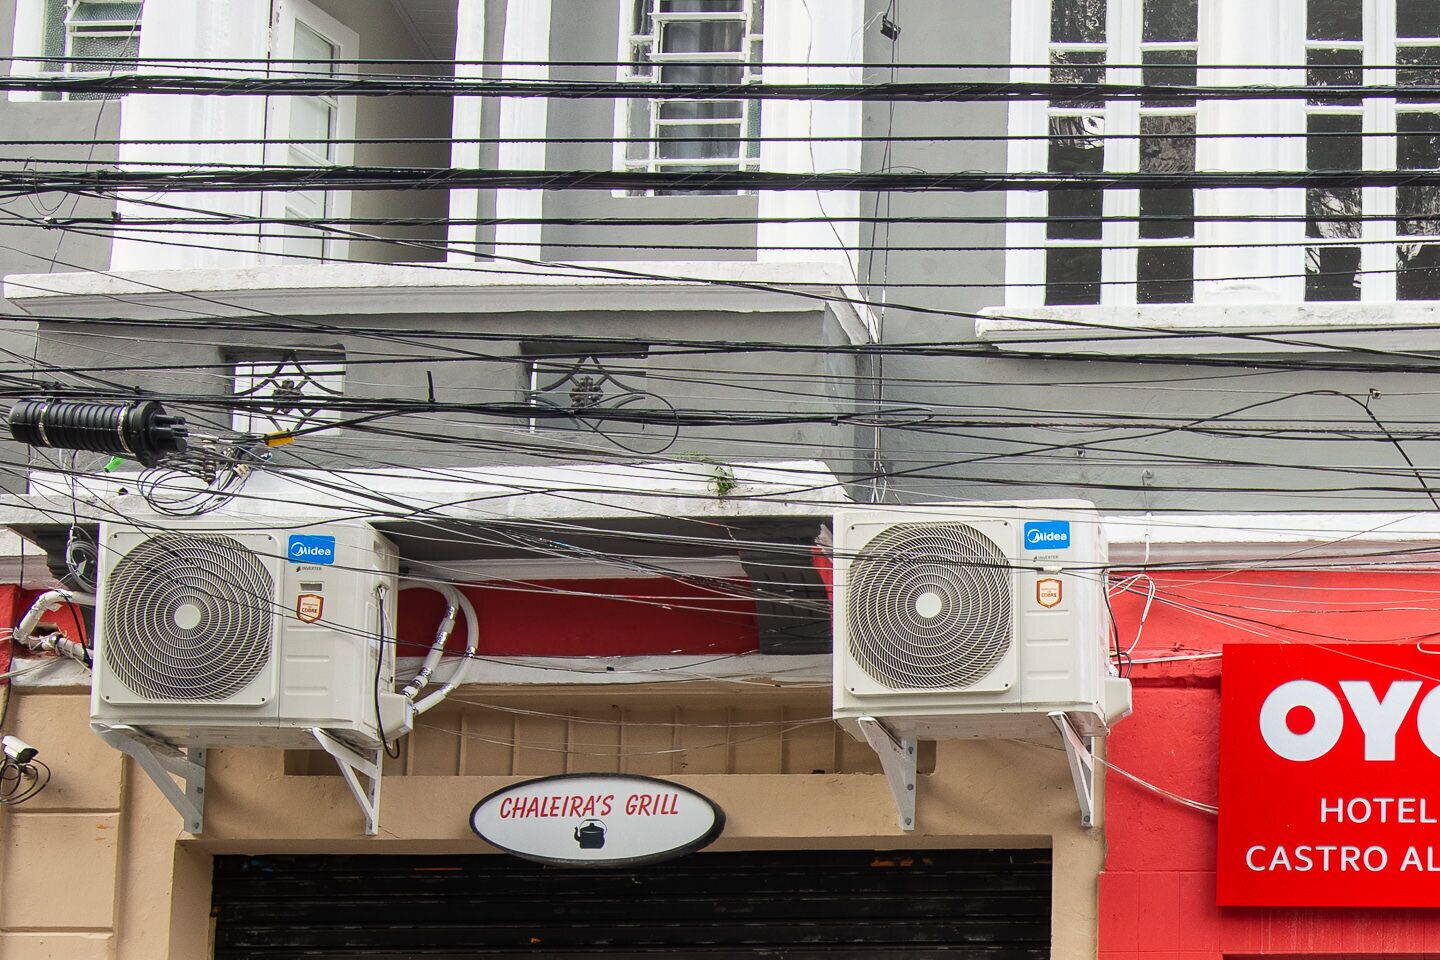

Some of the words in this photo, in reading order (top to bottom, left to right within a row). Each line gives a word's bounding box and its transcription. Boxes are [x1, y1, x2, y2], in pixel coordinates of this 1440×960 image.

[1034, 531, 1067, 542] Midea
[297, 545, 331, 556] Midea
[500, 794, 614, 819] CHALEIRA'S
[625, 793, 679, 816] GRILL
[1320, 797, 1437, 823] HOTEL
[1245, 845, 1388, 872] CASTRO
